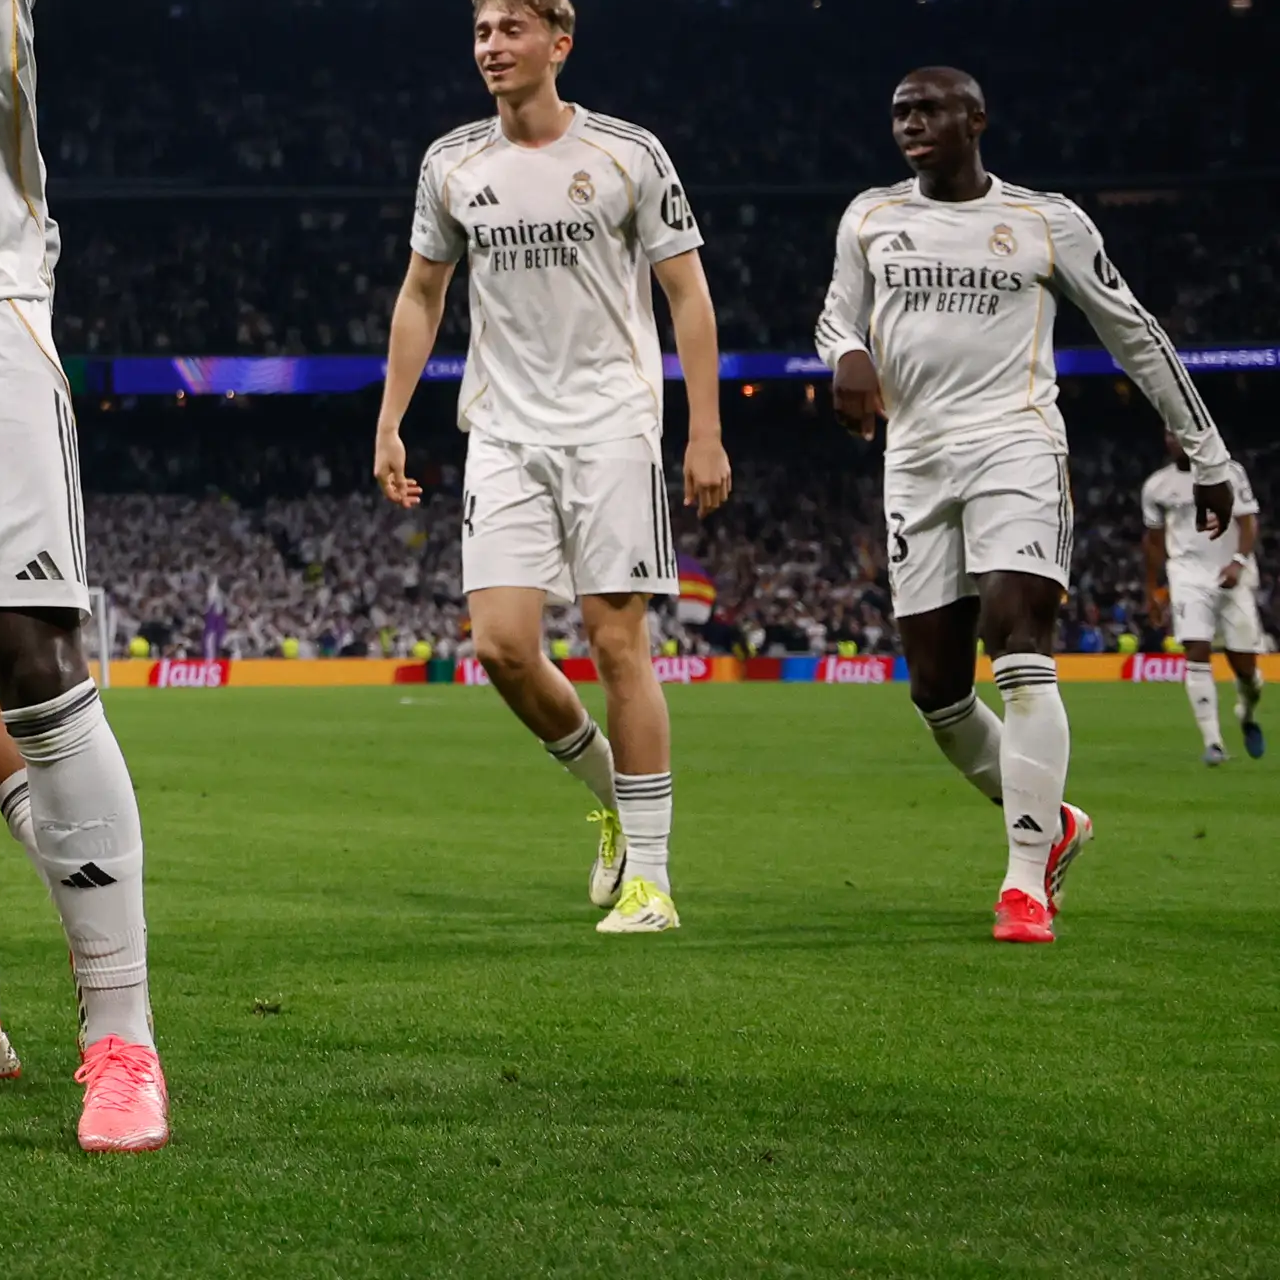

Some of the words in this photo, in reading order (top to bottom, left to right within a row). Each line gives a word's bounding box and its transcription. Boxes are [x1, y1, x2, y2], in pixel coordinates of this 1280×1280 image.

[473, 220, 595, 249] Emirates
[494, 251, 518, 271] FLY
[524, 247, 579, 269] BETTER
[884, 262, 1022, 292] Emirates
[904, 292, 930, 312] FLY
[936, 292, 1000, 315] BETTER
